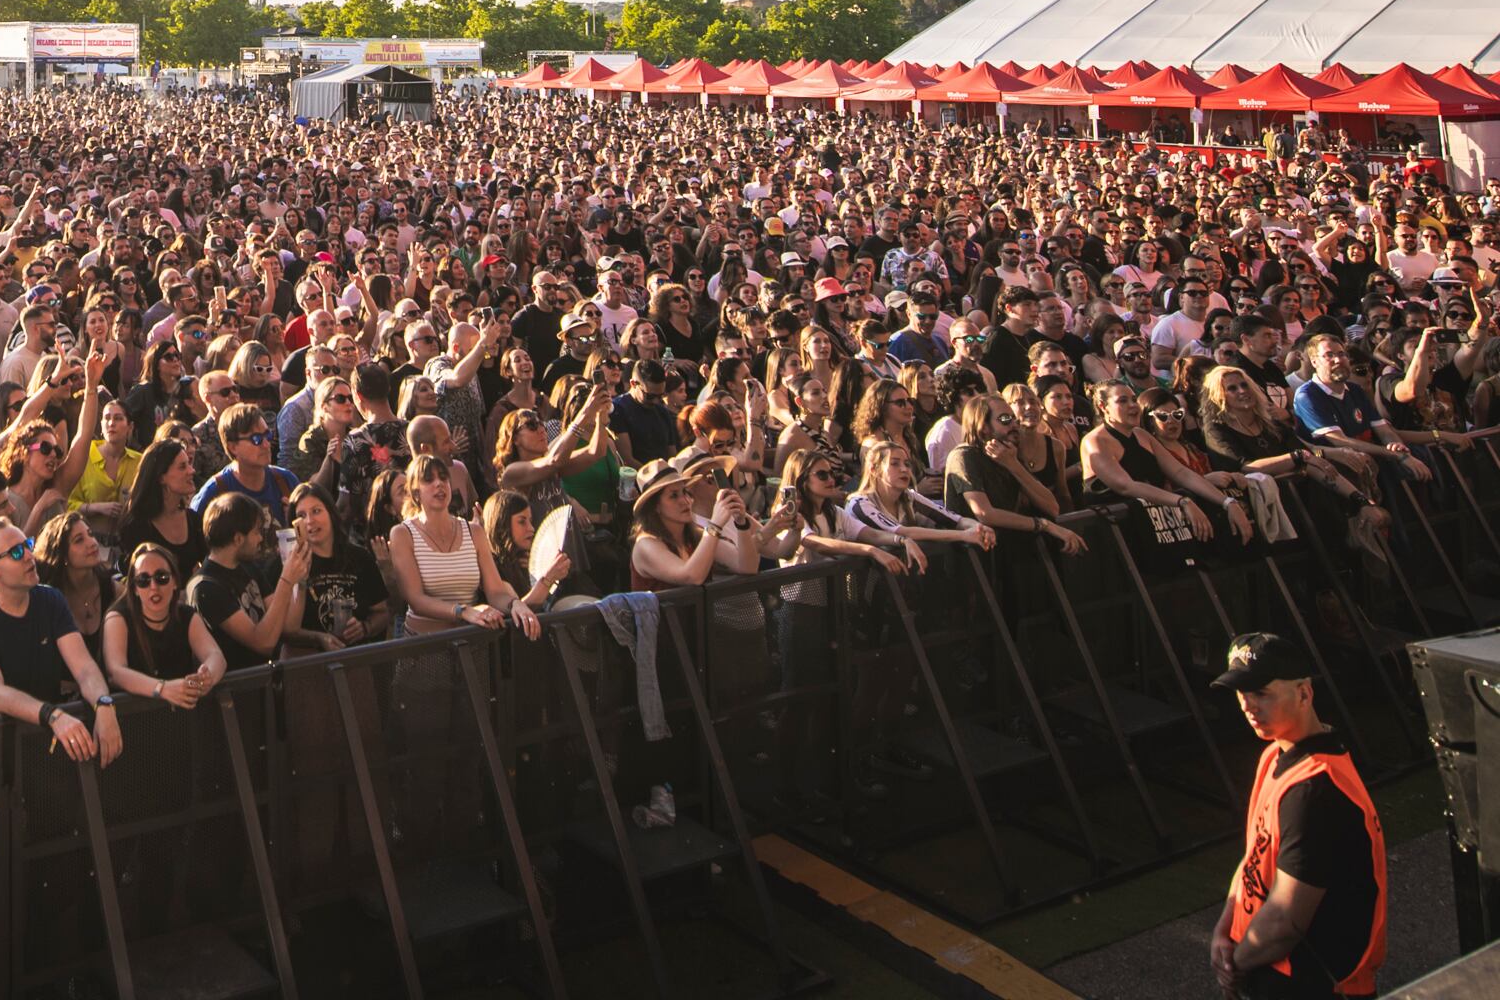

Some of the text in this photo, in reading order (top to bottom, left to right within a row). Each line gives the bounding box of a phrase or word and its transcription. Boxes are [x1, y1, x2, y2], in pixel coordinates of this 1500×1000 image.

[381, 43, 407, 52] VUELVE A
[365, 53, 423, 61] CASTILLA LA MANCHA
